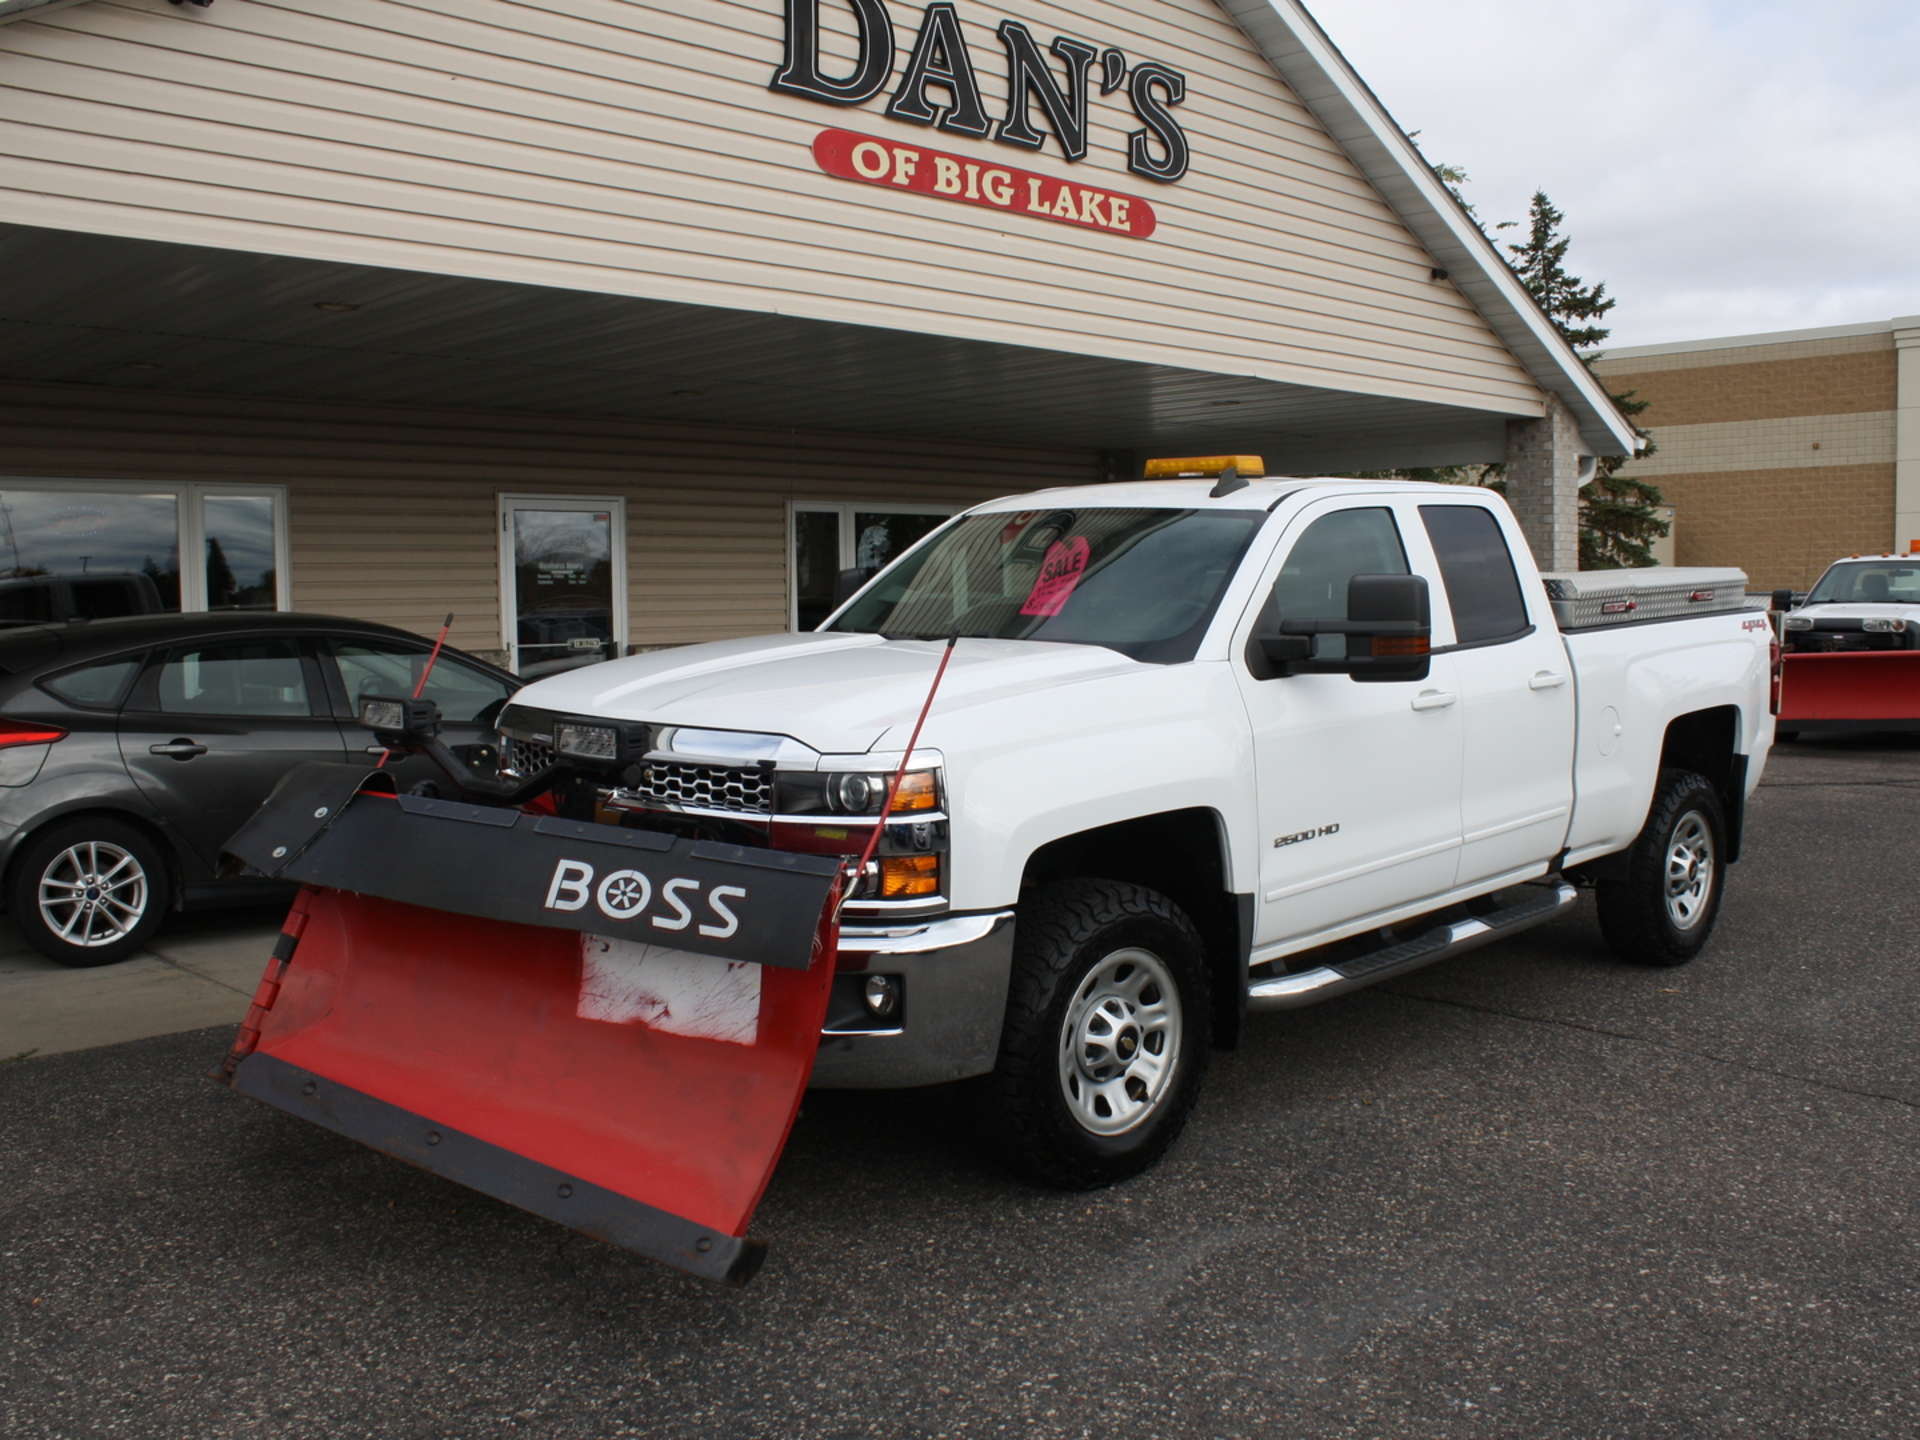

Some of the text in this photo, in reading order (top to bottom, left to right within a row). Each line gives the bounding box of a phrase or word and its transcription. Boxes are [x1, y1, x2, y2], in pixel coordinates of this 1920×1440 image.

[769, 0, 1190, 183] DAN'S
[851, 141, 1131, 232] OF BIG LAKE
[1043, 551, 1082, 582] SALE
[1273, 823, 1339, 848] 2500 HD
[544, 858, 747, 939] BOSS
